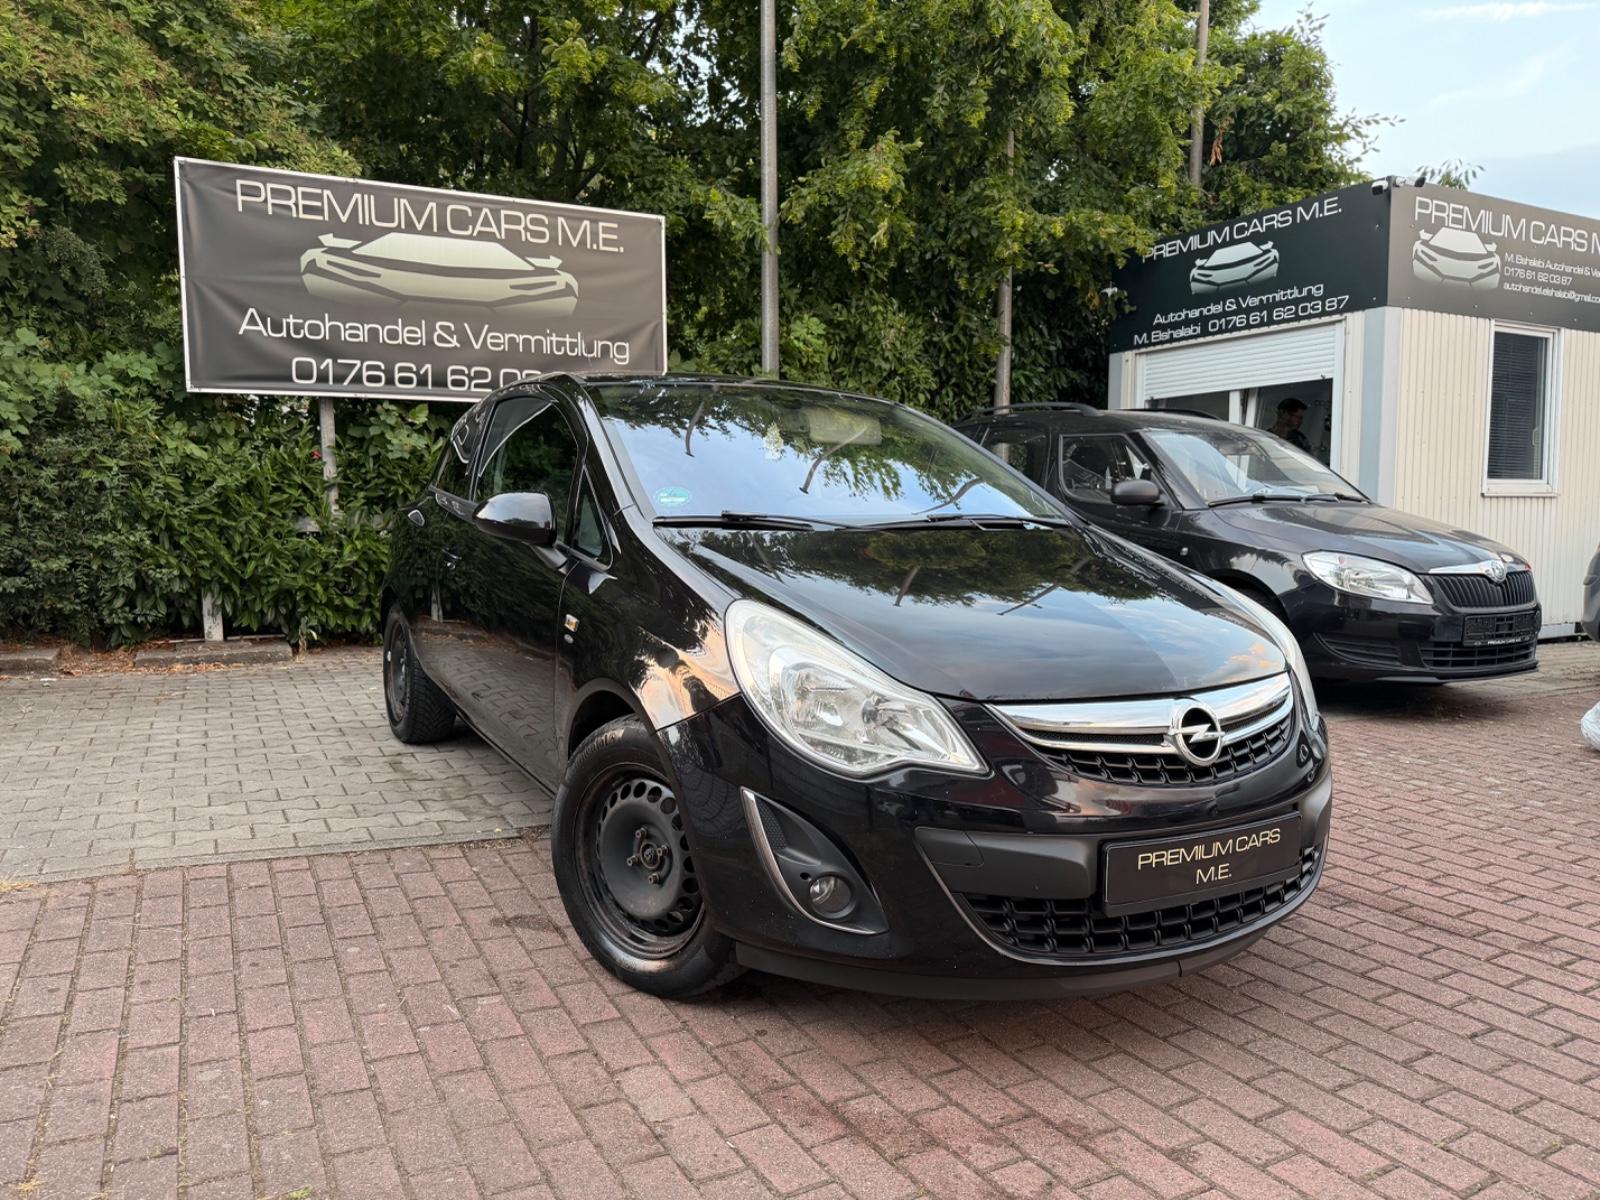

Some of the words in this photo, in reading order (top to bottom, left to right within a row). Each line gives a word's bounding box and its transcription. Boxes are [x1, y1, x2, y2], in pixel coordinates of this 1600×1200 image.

[236, 179, 438, 233] PREMIUM
[446, 204, 550, 244] CARS
[558, 218, 625, 253] M.E.
[1233, 209, 1292, 240] CARS
[1296, 196, 1342, 224] M.E.
[1414, 196, 1526, 241] PREMIUM
[1530, 220, 1588, 252] CARS
[1504, 266, 1525, 279] 0176
[1526, 269, 1536, 281] 61
[1537, 271, 1549, 283] 62
[1549, 273, 1561, 285] 03
[1561, 275, 1573, 287] 87
[1545, 259, 1584, 275] Autohandel
[1134, 333, 1149, 346] M.
[1208, 314, 1247, 332] 0176
[1249, 311, 1267, 326] 61
[1273, 305, 1296, 321] 62
[1298, 299, 1322, 317] 03
[1325, 295, 1349, 311] 87
[1153, 299, 1223, 326] Autohandel
[1225, 298, 1237, 312] &
[1239, 283, 1324, 309] Vermittlung
[238, 308, 426, 347] Autohandel
[434, 322, 460, 348] &
[464, 322, 630, 365] Vermittlung
[292, 357, 385, 387] 0176
[395, 361, 432, 389] 61
[447, 365, 492, 391] 62
[1137, 838, 1232, 871] PREMIUM
[1235, 828, 1281, 852] CARS
[1195, 863, 1232, 885] M.E.
